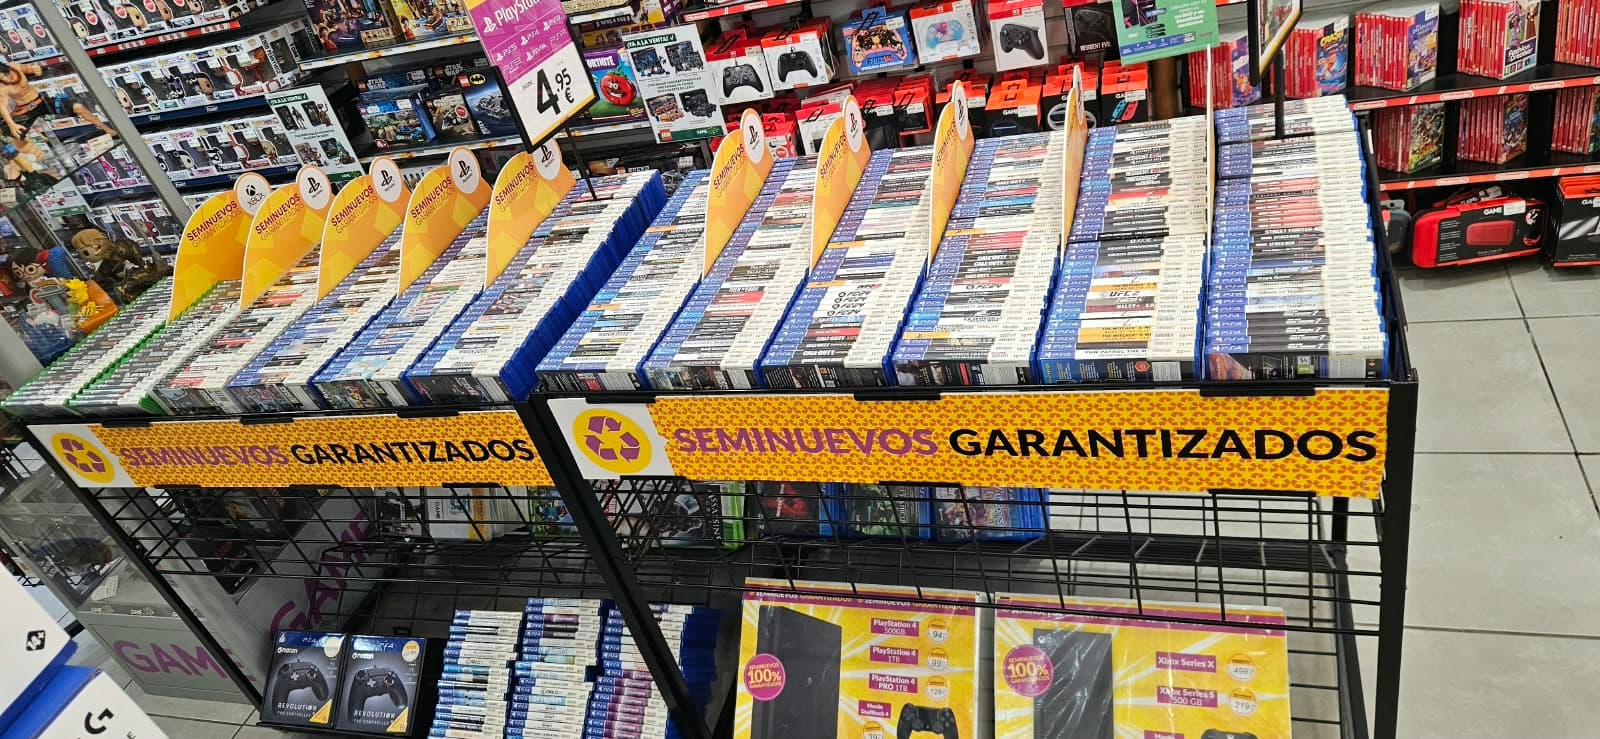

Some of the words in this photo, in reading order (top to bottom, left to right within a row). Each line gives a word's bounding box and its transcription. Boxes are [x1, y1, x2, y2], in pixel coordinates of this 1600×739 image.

[586, 56, 616, 69] ORTNITE
[565, 87, 575, 104] €
[820, 131, 847, 179] SEMINUEVOS
[714, 144, 744, 190] SEMINUEVOS
[494, 161, 535, 205] SEMINUEVOS
[248, 192, 266, 206] XBOX
[411, 176, 452, 219] SEMINUEVOS
[500, 170, 538, 213] GARANTIZADOS
[255, 192, 301, 234] SEMINUEVOS
[331, 184, 374, 227] SEMINUEVOS
[415, 186, 456, 226] GARANTIZADOS
[1484, 206, 1502, 216] GAME
[187, 200, 238, 242] SEMINUEVOS
[260, 202, 305, 242] GARANTIZADOS
[336, 194, 379, 234] GARANTIZADOS
[192, 208, 243, 248] GARANTIZADOS
[672, 427, 938, 456] SEMINUEVOS
[948, 428, 1377, 462] GARANTIZADOS
[118, 444, 290, 470] SEMINUEVOS
[290, 438, 536, 464] GARANTIZADOS
[873, 620, 910, 630] PlayStation
[884, 627, 906, 635] 500GB
[872, 646, 910, 656] PlayStation
[1008, 655, 1045, 664] SEMINUEVOS
[1158, 656, 1180, 666] Xbox
[1180, 657, 1206, 668] Series
[1206, 660, 1215, 669] X
[748, 669, 782, 682] 100%
[1007, 662, 1048, 678] 100%
[872, 674, 910, 684] PlayStation
[878, 682, 894, 691] PRO
[895, 684, 908, 692] 1TB
[1159, 686, 1180, 696] Xbox
[1182, 688, 1208, 698] Series
[1208, 690, 1215, 698] S
[278, 702, 318, 711] REVOLUTION
[1172, 696, 1188, 705] 500
[1190, 698, 1202, 706] GB
[354, 710, 396, 719] REVOLUTION
